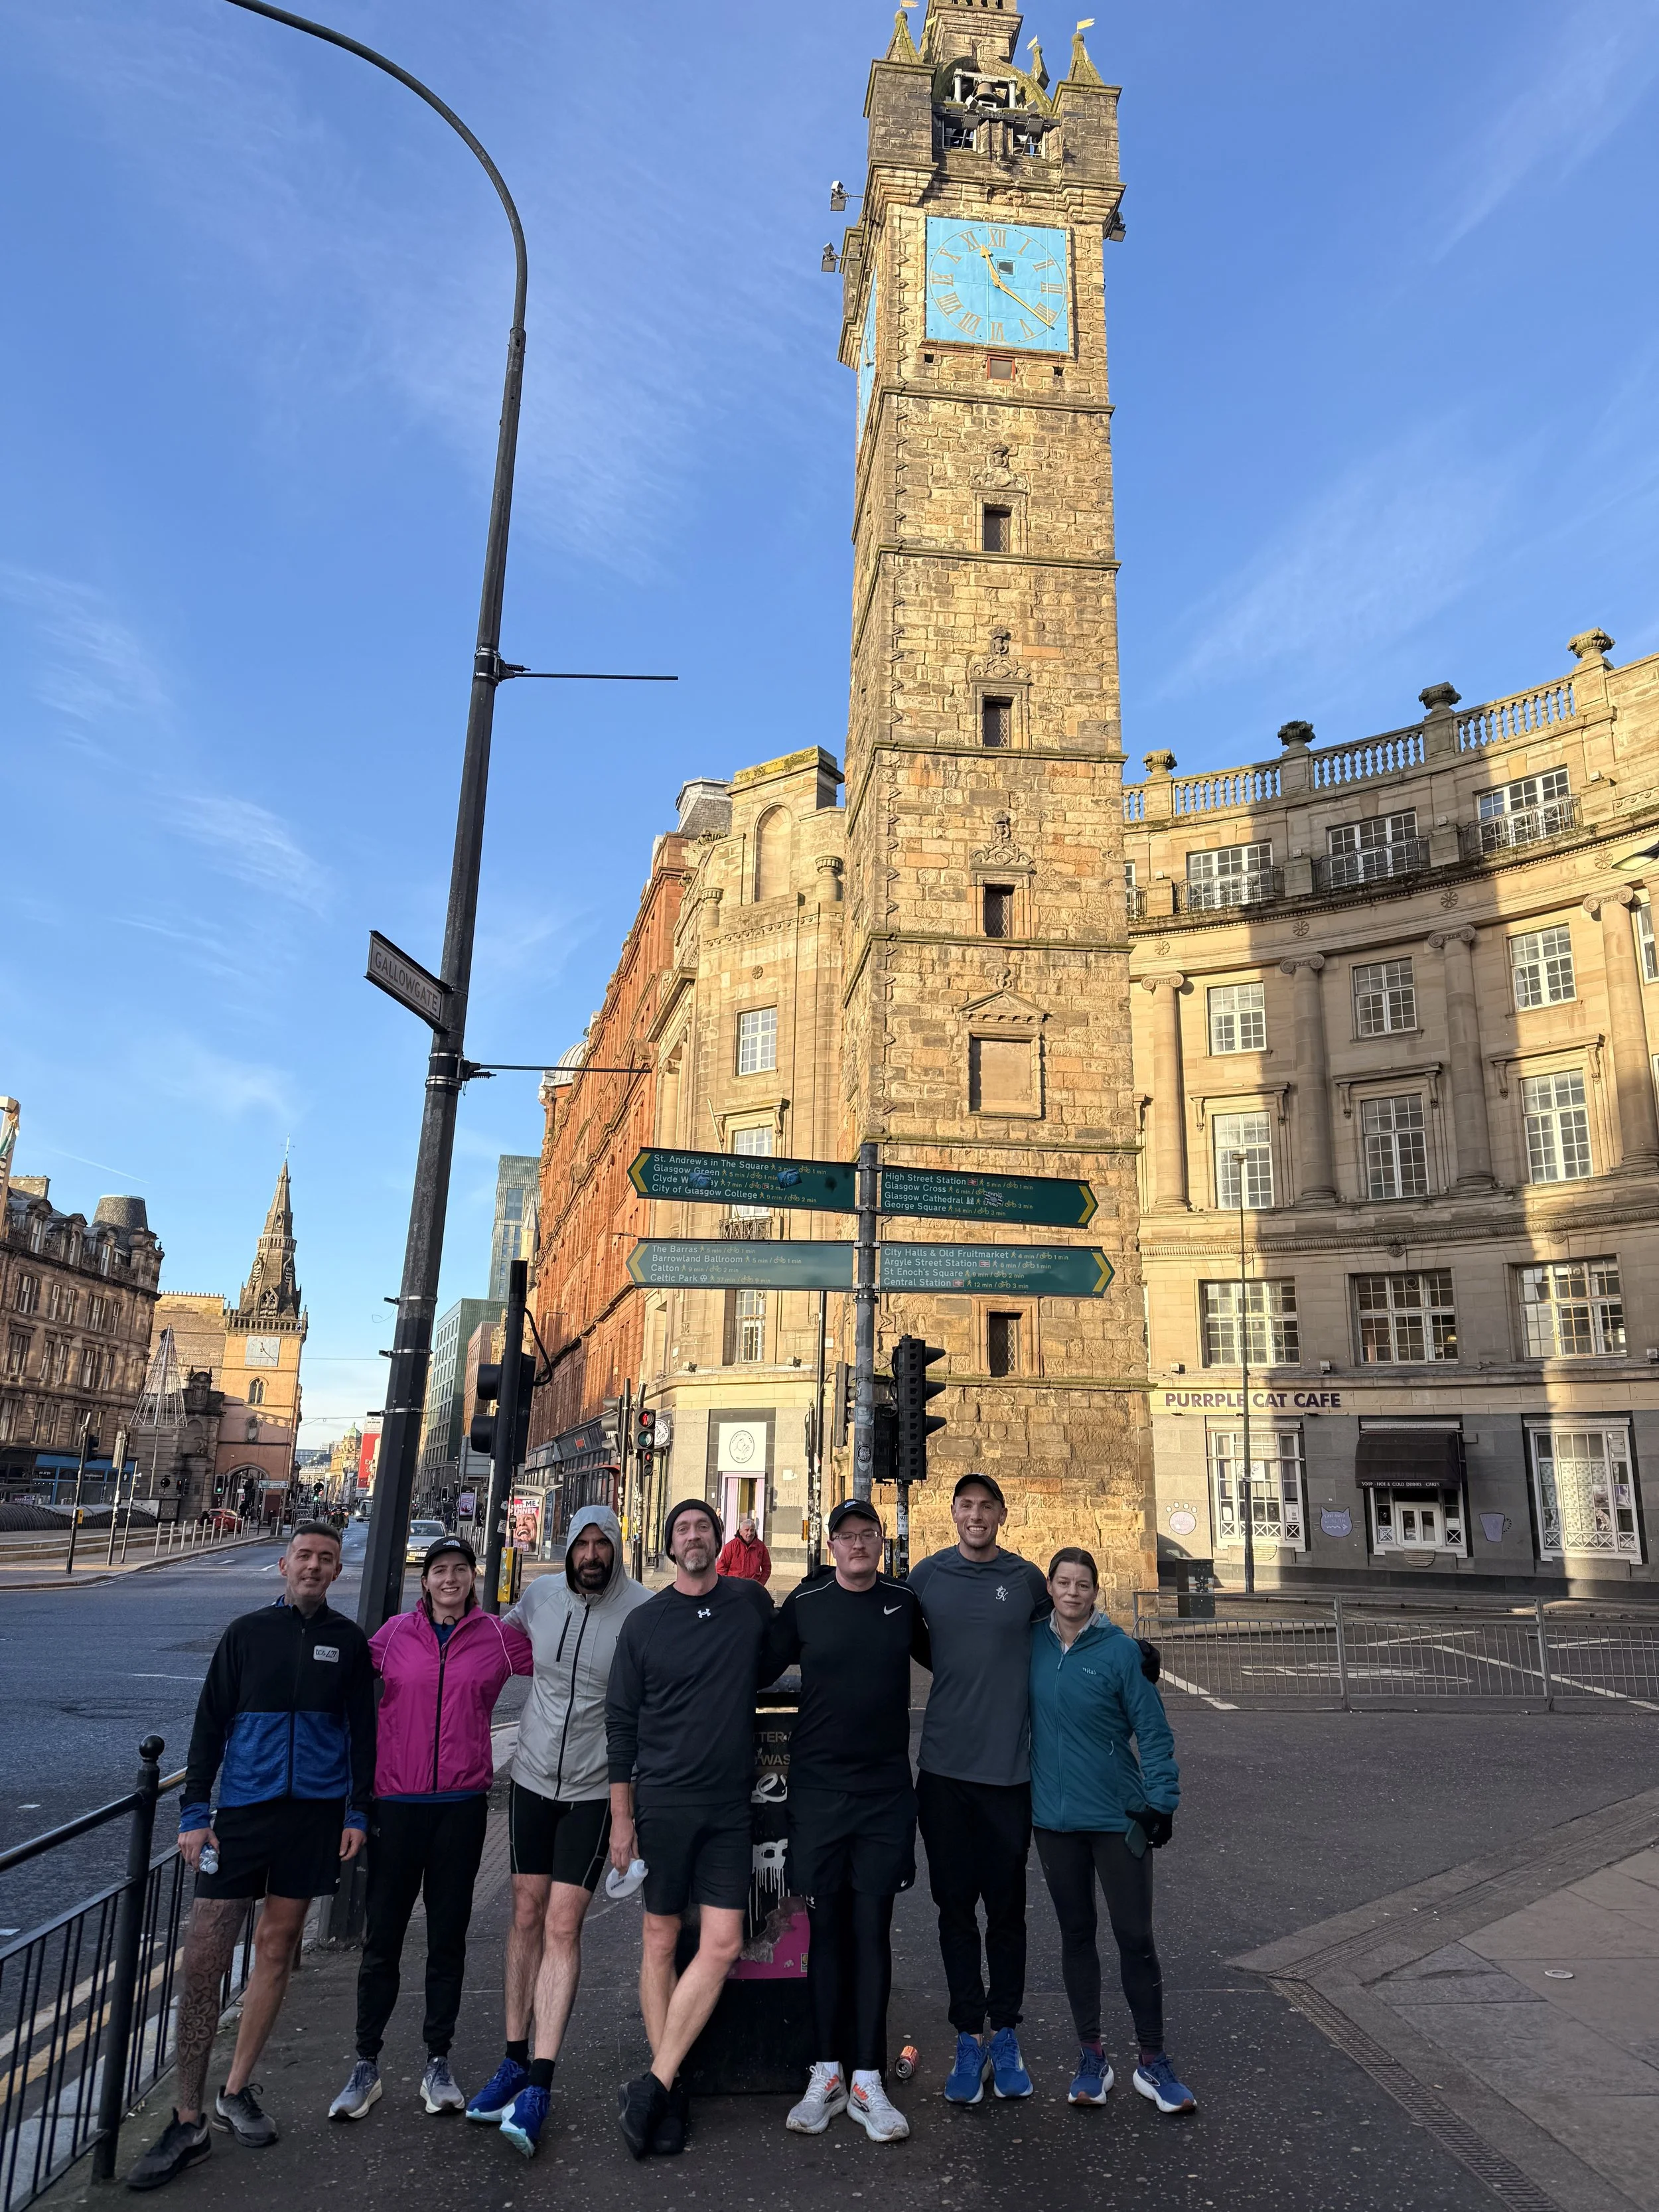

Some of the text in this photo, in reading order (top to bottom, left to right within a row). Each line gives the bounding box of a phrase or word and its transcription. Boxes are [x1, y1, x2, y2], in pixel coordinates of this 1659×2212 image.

[375, 952, 438, 1012] GALLOWGATE
[670, 1156, 707, 1165] Andrew's
[654, 1164, 690, 1174] Glasgow
[694, 1167, 719, 1176] Green
[652, 1174, 678, 1183] Clyde
[886, 1173, 904, 1181] High
[908, 1174, 933, 1183] Street
[936, 1176, 966, 1185] Station
[652, 1184, 670, 1193] City
[685, 1187, 721, 1197] Glasgow
[725, 1189, 757, 1200] College
[885, 1182, 920, 1191] Glasgow
[885, 1192, 920, 1201] Glasgow
[922, 1195, 964, 1204] Cathedral
[885, 1201, 914, 1210] George
[885, 1248, 901, 1257] City
[958, 1250, 1008, 1259] Fruitmarket
[933, 1269, 963, 1278] Square
[1165, 1393, 1341, 1408] PURRPLE CAT CAFE
[760, 1754, 790, 1765] WAS
